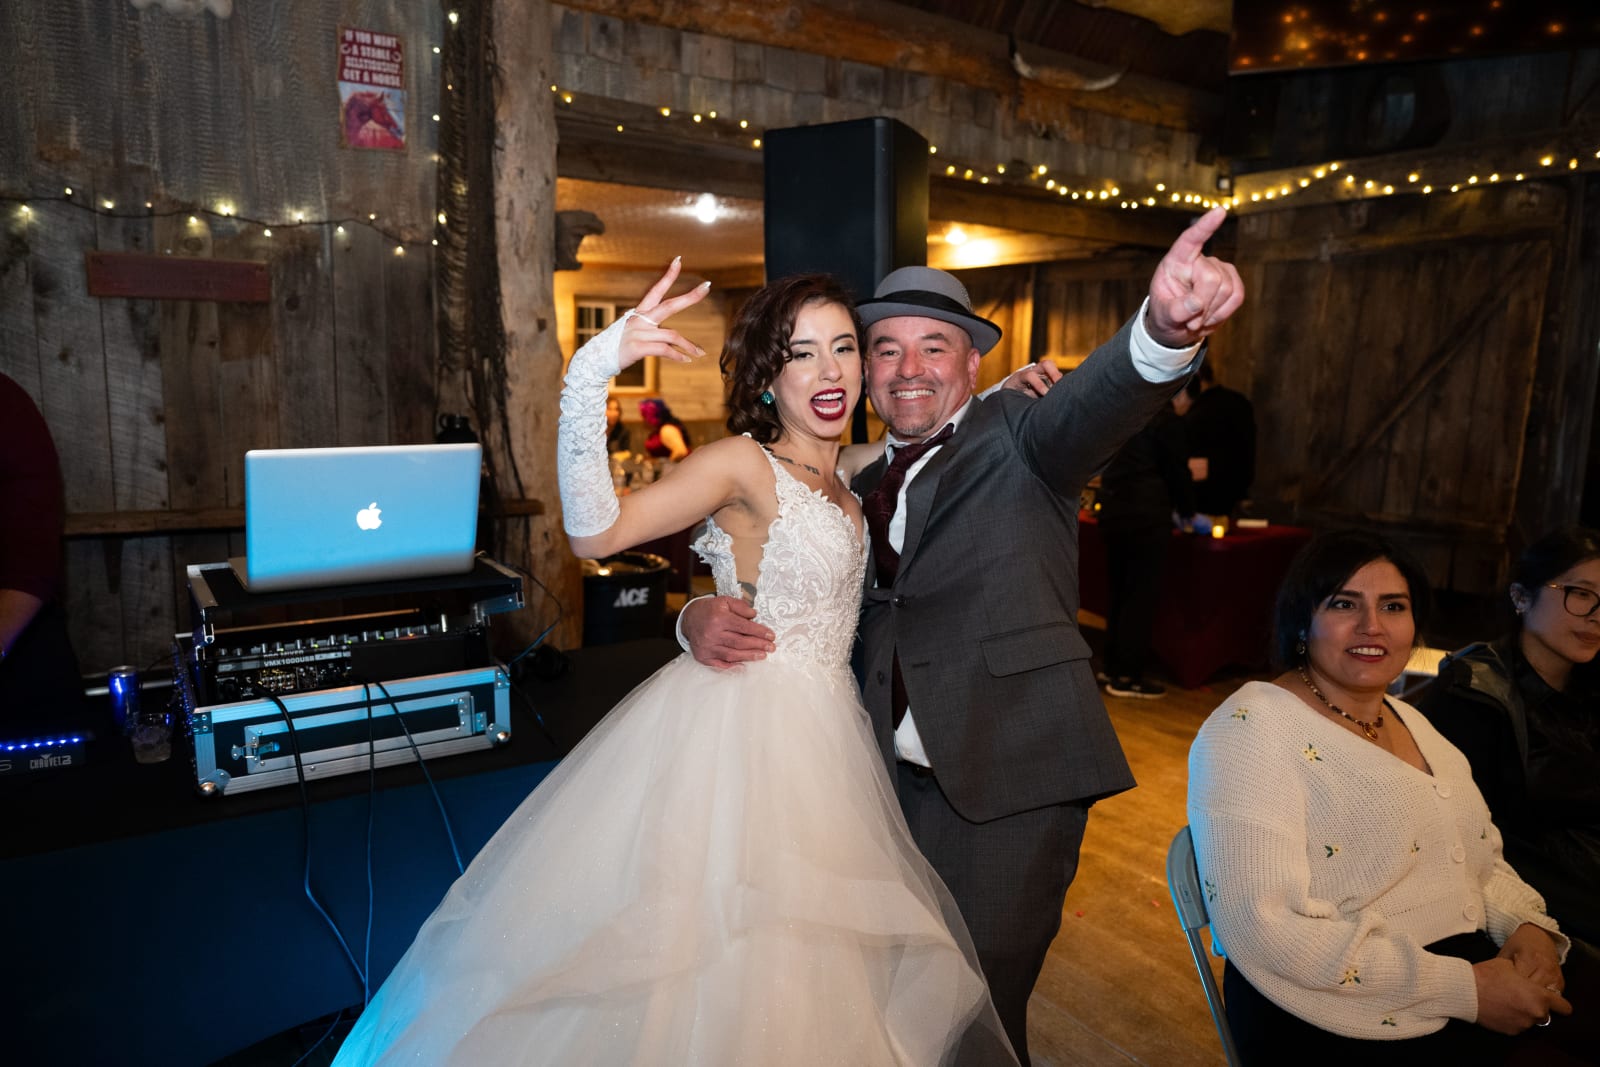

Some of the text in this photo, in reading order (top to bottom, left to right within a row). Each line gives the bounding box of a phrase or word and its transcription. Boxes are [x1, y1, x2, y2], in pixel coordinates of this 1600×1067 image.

[345, 30, 397, 48] IF YOU WANT
[352, 44, 390, 60] A STABLE
[343, 68, 400, 87] GET A HORSE
[613, 587, 650, 608] ACE
